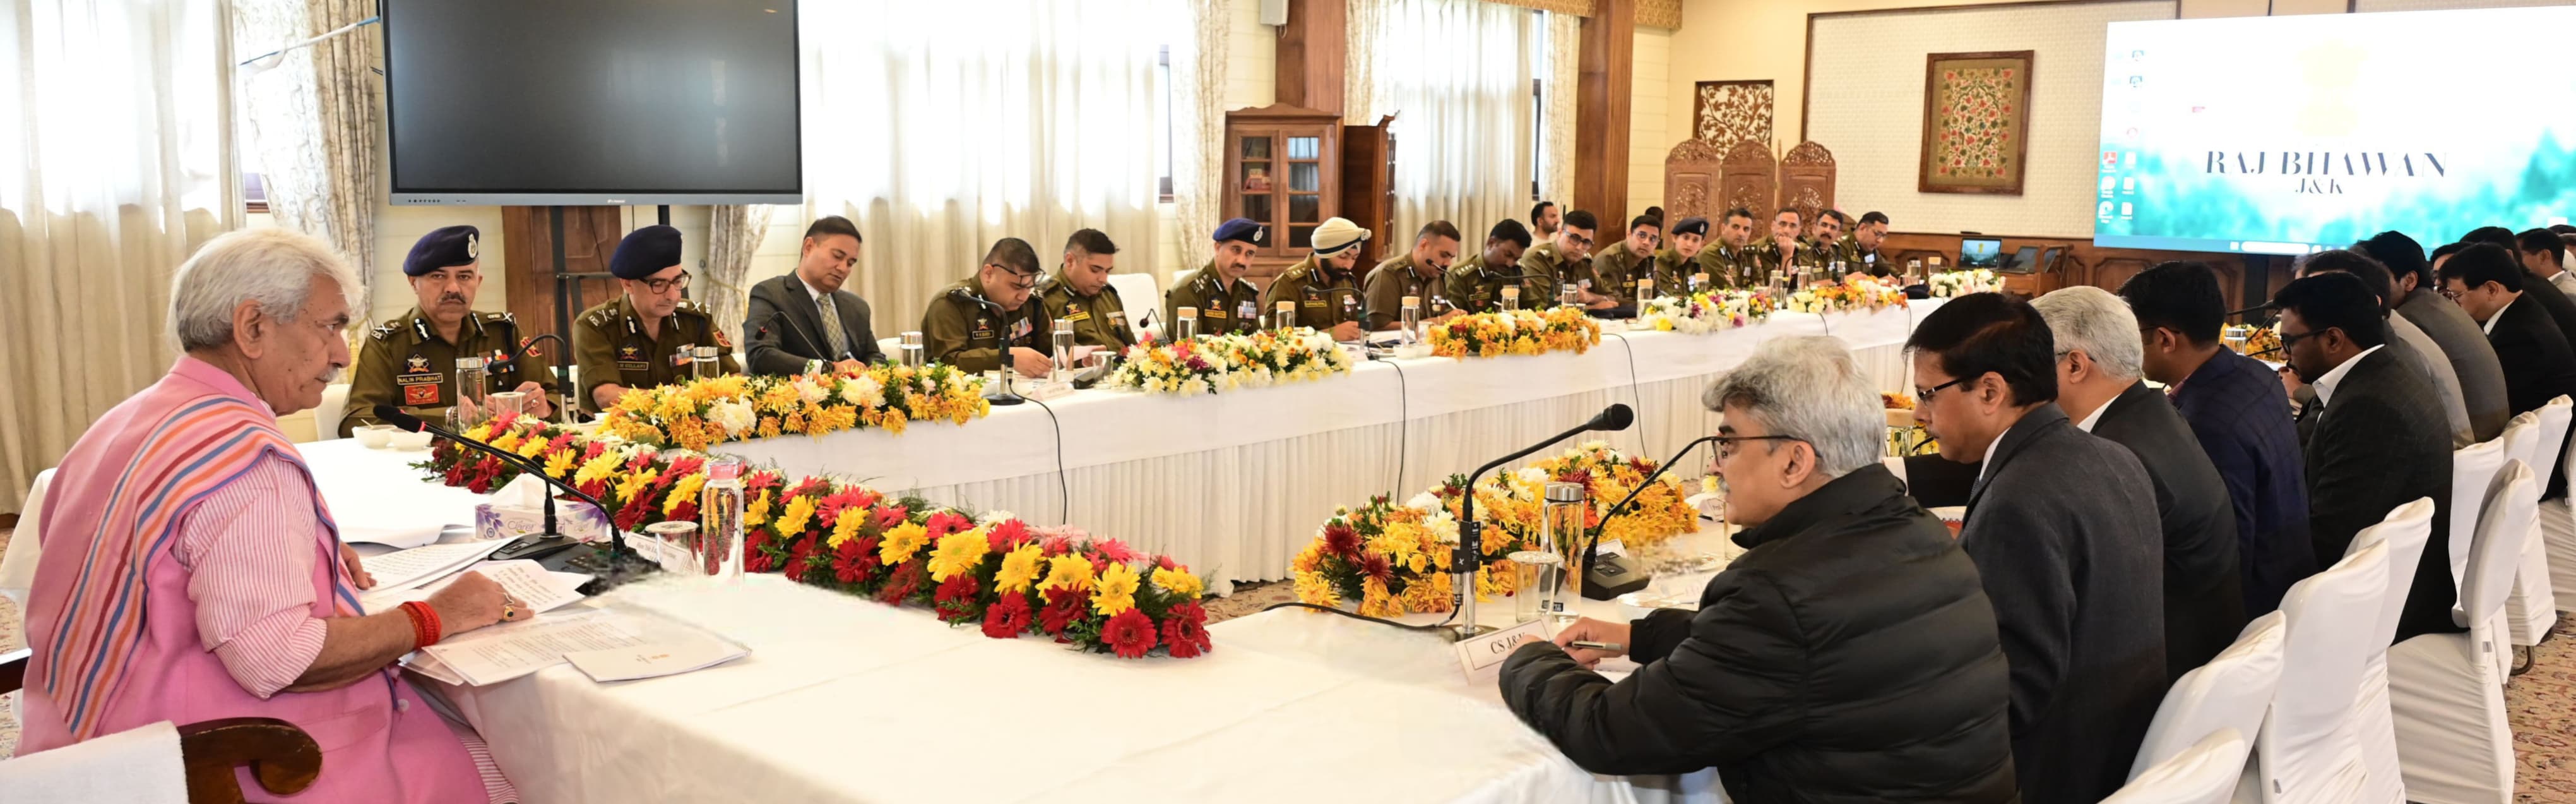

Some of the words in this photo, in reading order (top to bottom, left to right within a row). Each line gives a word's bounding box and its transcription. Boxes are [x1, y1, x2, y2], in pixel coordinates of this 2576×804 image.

[2206, 151, 2265, 174] RAJ
[2281, 151, 2447, 177] BHAWAN
[2295, 177, 2344, 195] J&K
[507, 520, 535, 532] Claret
[1490, 640, 1506, 654] CS
